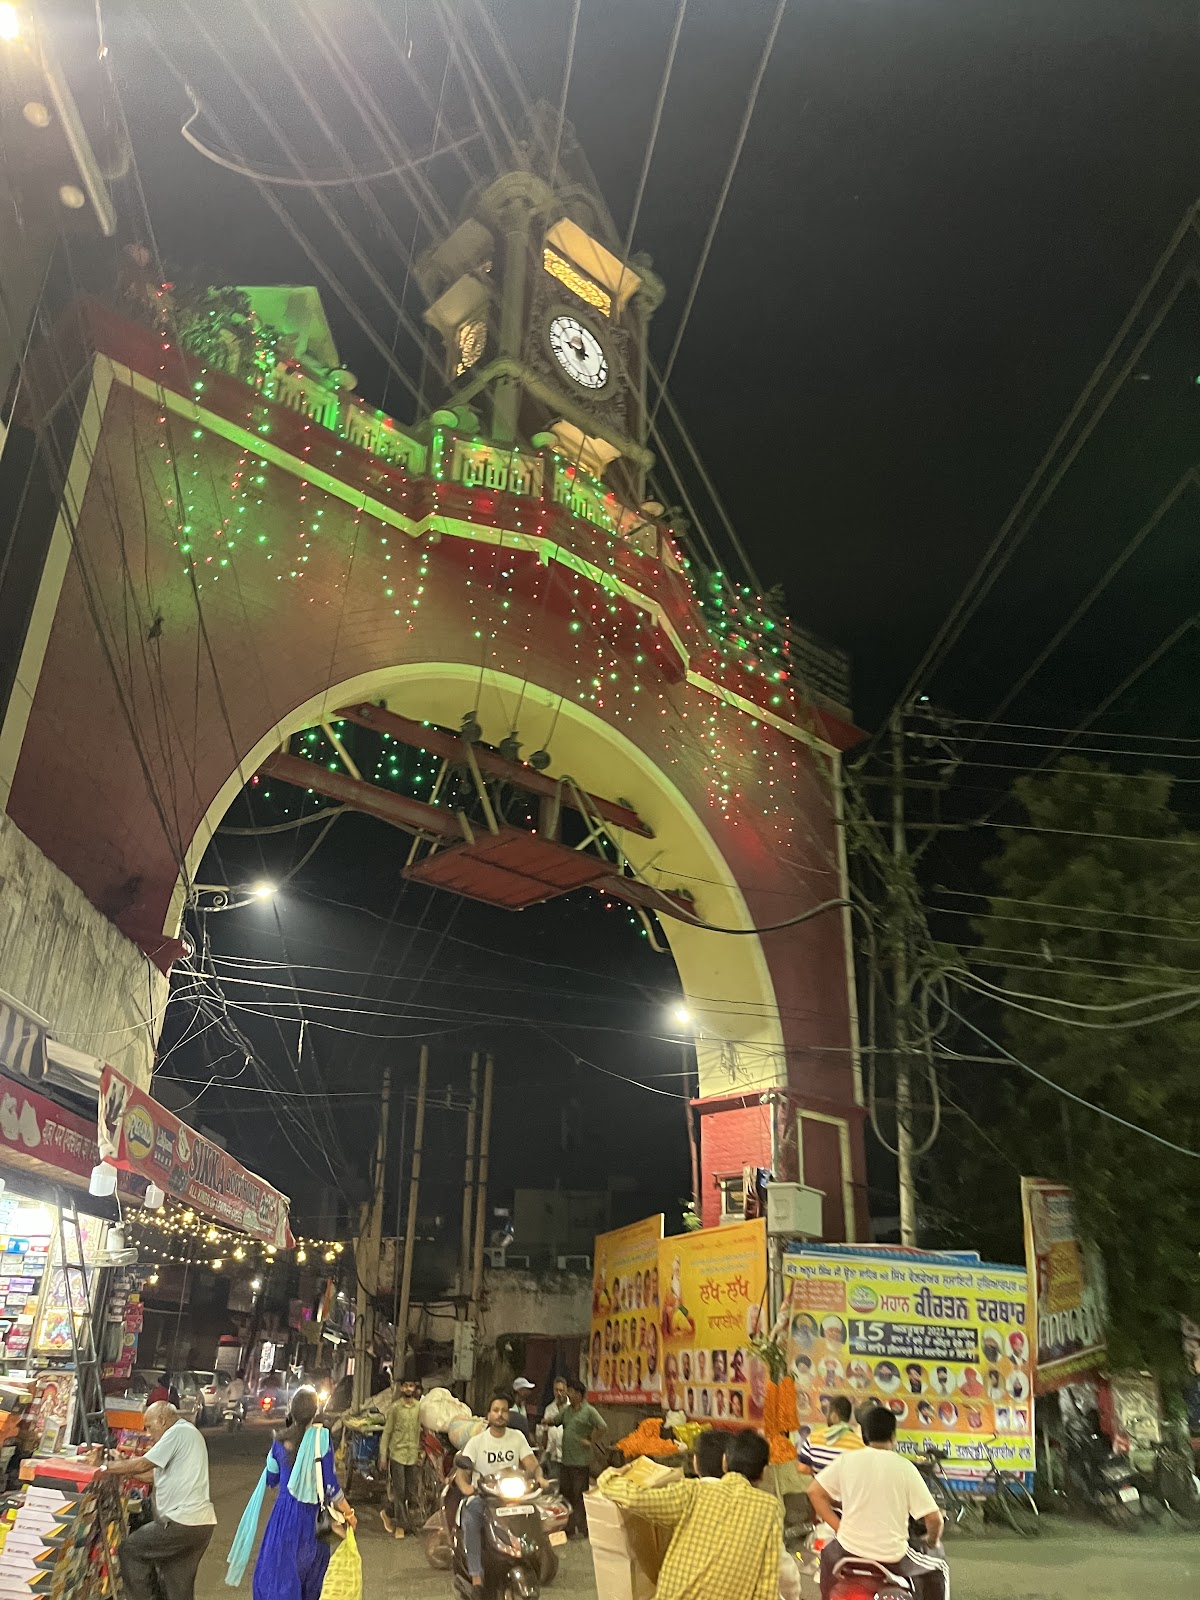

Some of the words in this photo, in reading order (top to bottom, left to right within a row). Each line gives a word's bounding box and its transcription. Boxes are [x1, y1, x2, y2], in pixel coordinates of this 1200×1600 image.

[188, 1138, 225, 1197] SIKKA
[880, 1295, 910, 1313] ਮਹਾਨ
[913, 1286, 969, 1320] ਕੀਰਤਨ
[975, 1298, 1026, 1325] ਦਰਬਾਰ
[855, 1321, 885, 1341] 15
[487, 1450, 515, 1464] D&G
